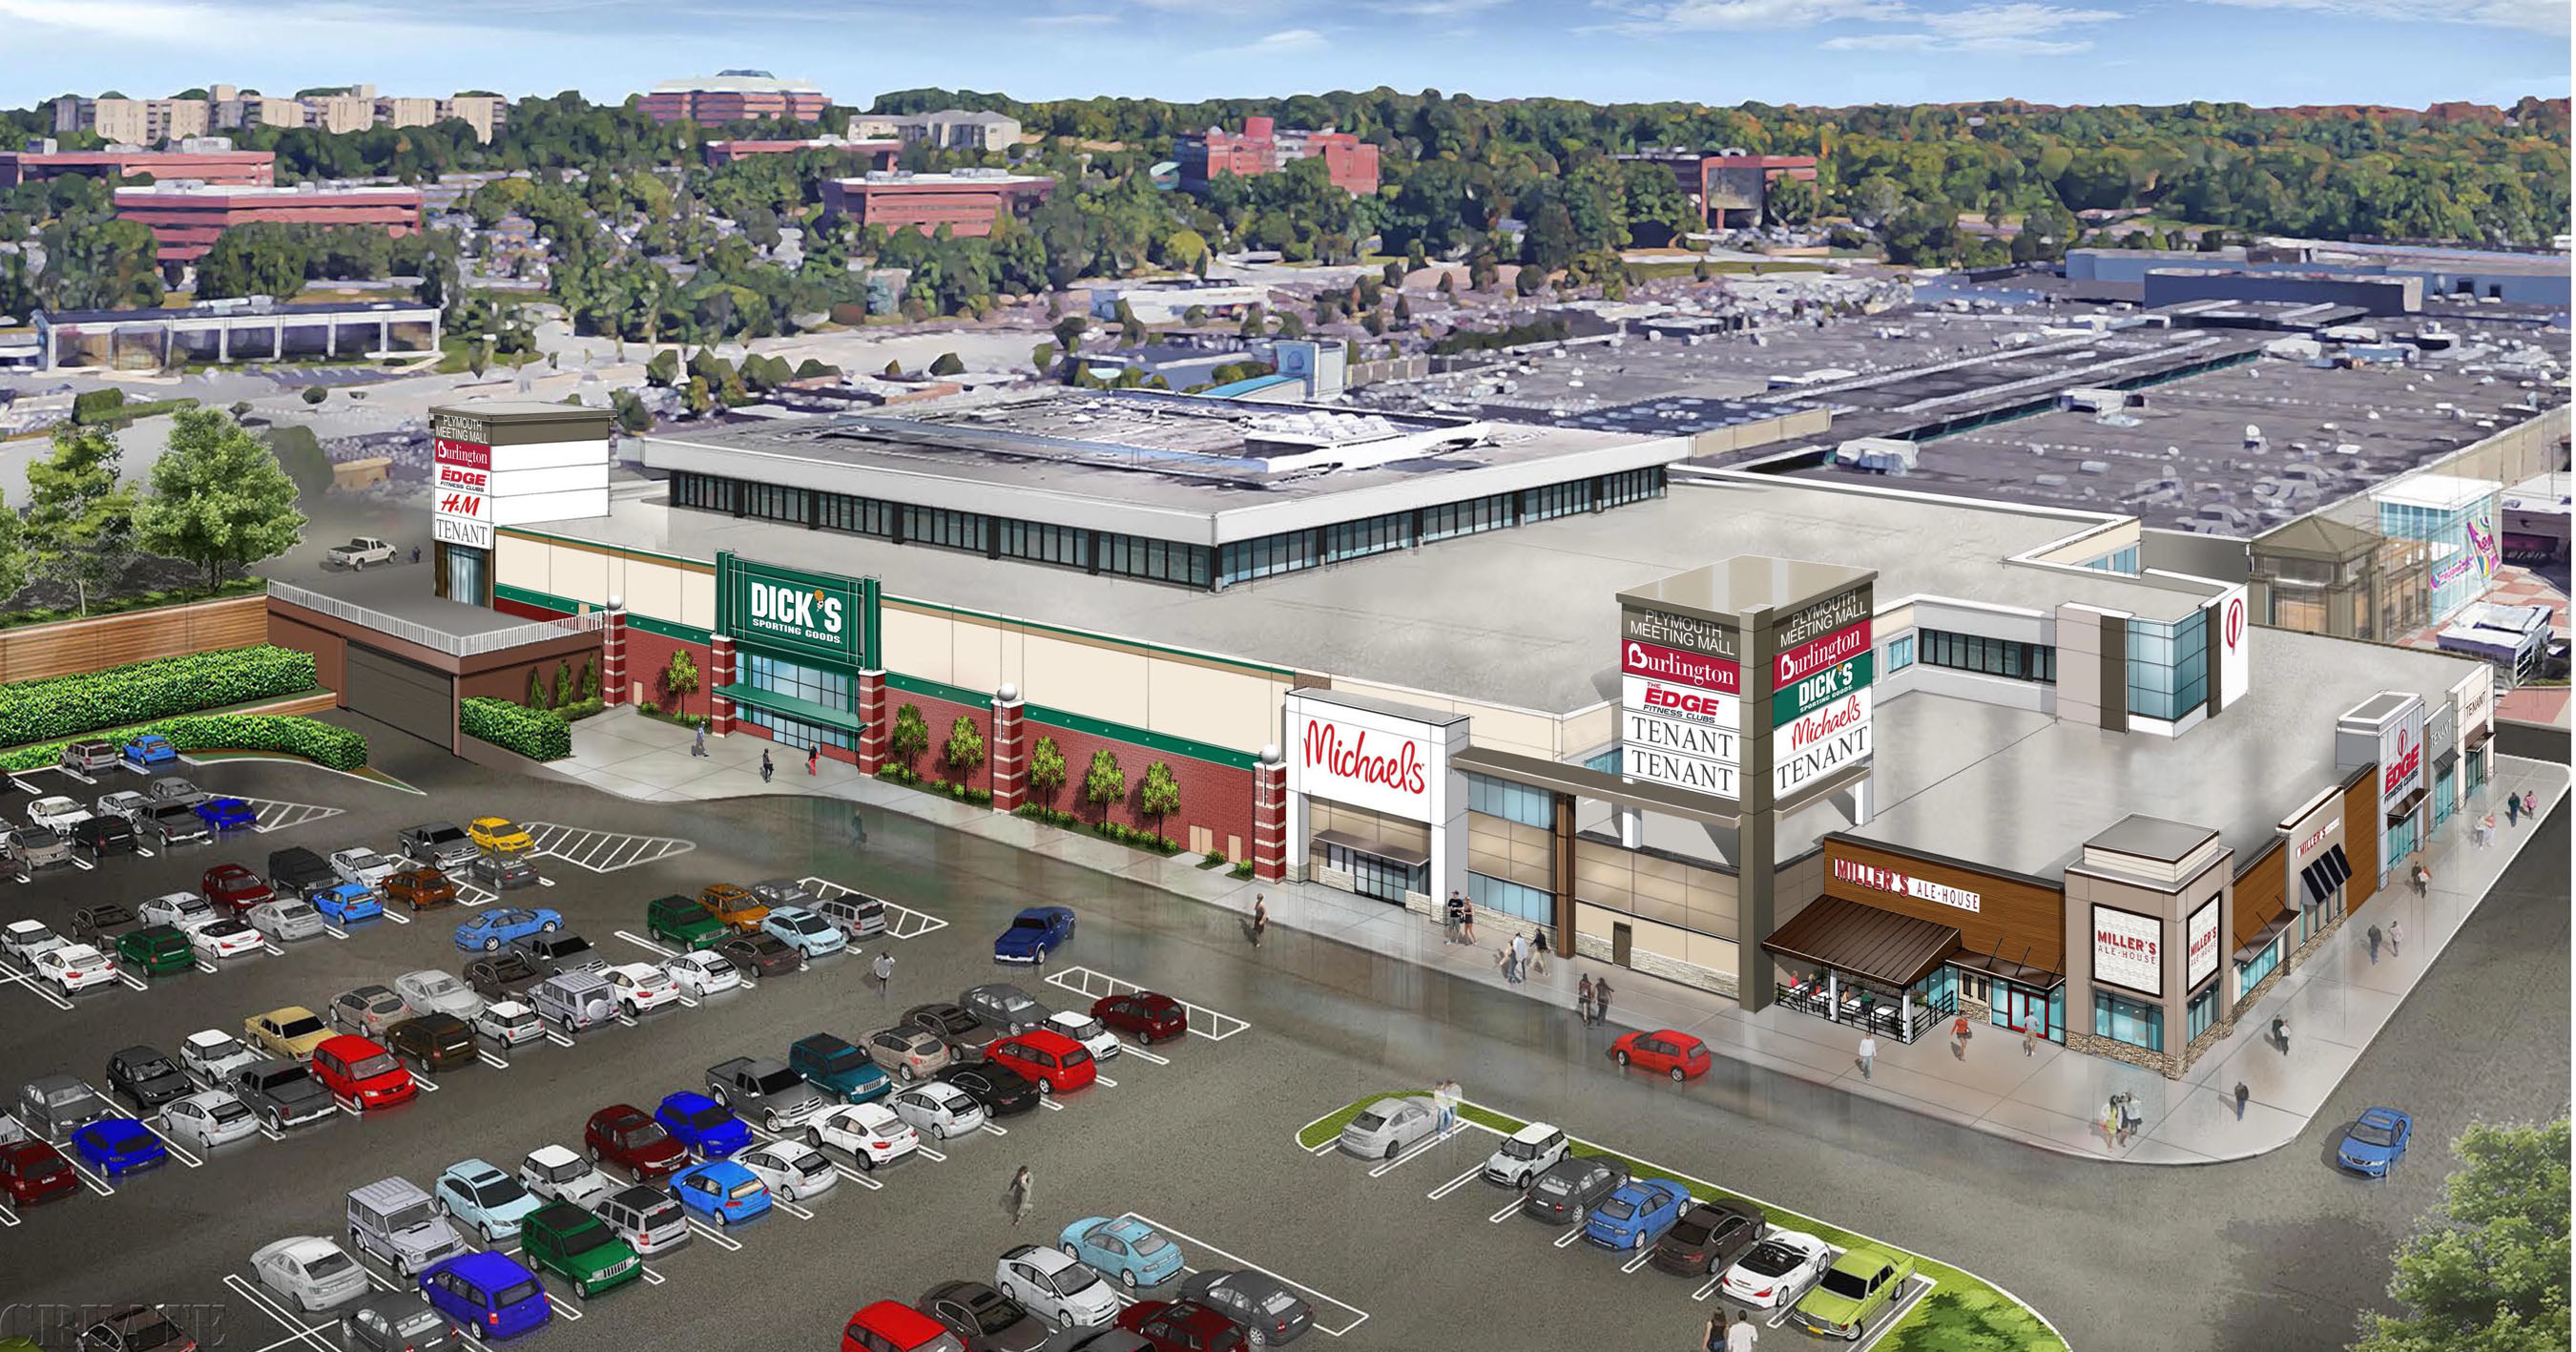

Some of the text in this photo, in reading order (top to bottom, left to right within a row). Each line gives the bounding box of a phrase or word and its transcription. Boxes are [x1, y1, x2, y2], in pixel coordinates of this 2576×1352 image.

[436, 425, 488, 445] MEETING MALL
[443, 414, 482, 431] PLYMOUTH
[438, 440, 488, 467] Burlington
[440, 481, 465, 489] FITNESS
[441, 468, 487, 487] EDGE
[441, 492, 481, 516] H&M
[436, 518, 488, 545] TENANT
[751, 581, 842, 634] DICK'S
[1792, 590, 1857, 629] PLYMOUTH
[752, 618, 841, 644] SPORTING GOODS
[1630, 620, 1735, 655] MEETING MALL
[1645, 609, 1722, 638] PLYMOUTH
[1780, 601, 1867, 649] MEETING MALL
[1628, 642, 1735, 685] Burlington
[1780, 630, 1860, 683] Burlington
[1647, 681, 1661, 690] THE
[1798, 661, 1853, 708] DICK'S
[1799, 684, 1853, 714] SPORTING GOODS
[1643, 704, 1715, 724] FITNESS CLUBS
[1644, 687, 1720, 717] EDGE
[2465, 690, 2486, 720] TENANT
[1631, 716, 1734, 758] TENANT
[1791, 694, 1861, 751] Michaels
[2430, 718, 2452, 749] TENANT
[1303, 719, 1425, 795] Michaels
[1631, 749, 1734, 792] TENANT
[1776, 726, 1868, 790] TENANT
[2384, 742, 2420, 795] EDGE
[1836, 856, 1911, 899] MILLER'S
[2097, 929, 2157, 956] MILLER'S
[2190, 926, 2217, 958] MILLER'S
